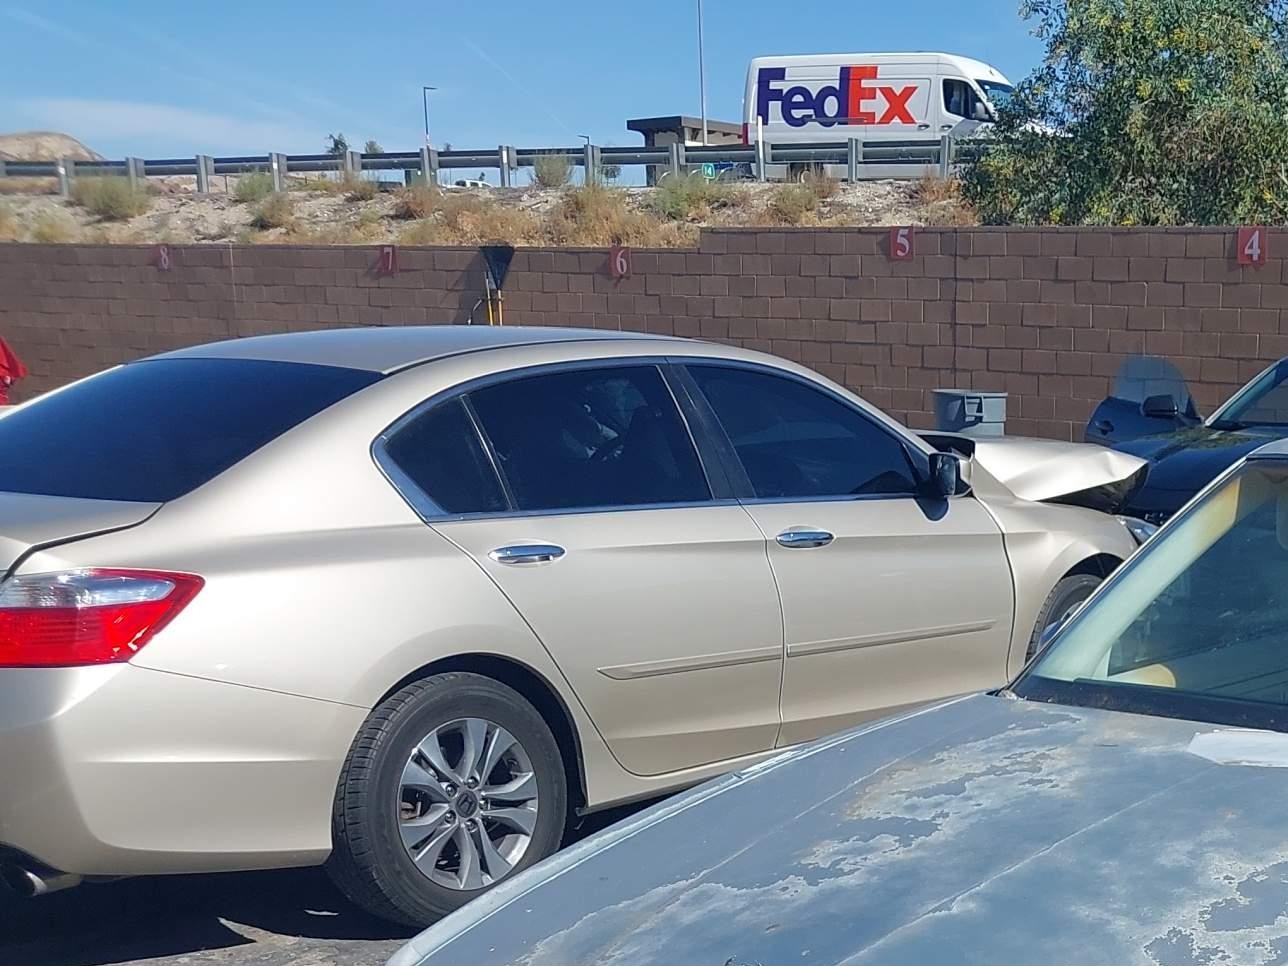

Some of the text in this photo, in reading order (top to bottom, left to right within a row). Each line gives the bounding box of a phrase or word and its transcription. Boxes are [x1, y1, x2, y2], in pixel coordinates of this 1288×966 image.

[757, 65, 919, 127] FedEx
[897, 228, 910, 257] 5
[1244, 230, 1261, 261] 4
[160, 246, 169, 270] 8
[383, 246, 393, 271] 7
[616, 248, 628, 274] 6
